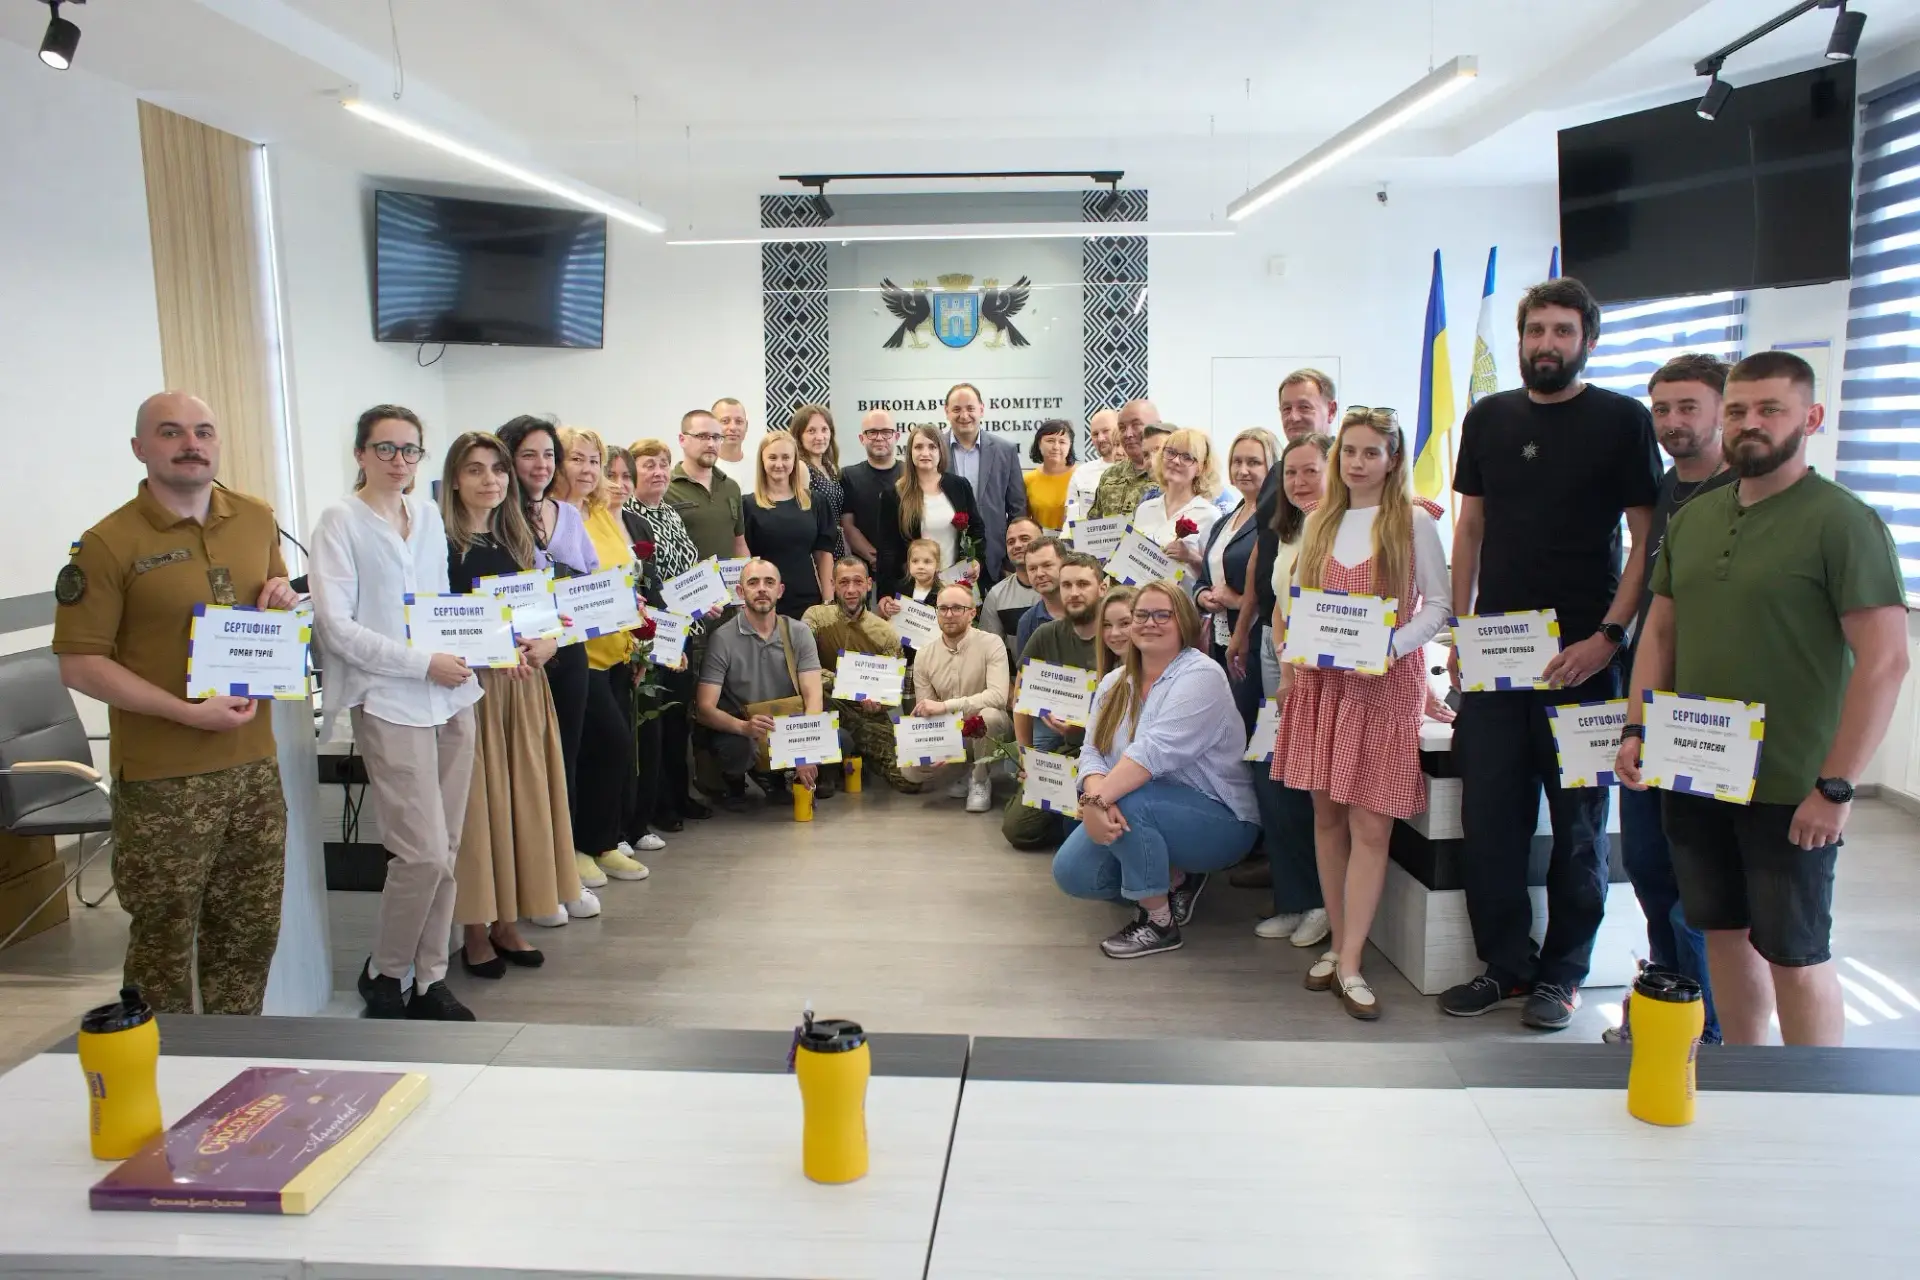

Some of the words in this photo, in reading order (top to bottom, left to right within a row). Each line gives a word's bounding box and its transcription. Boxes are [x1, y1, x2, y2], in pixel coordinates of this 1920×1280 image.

[858, 399, 946, 411] ВИКОНАВЧ
[989, 397, 1063, 409] КОМІТЕТ
[568, 580, 611, 595] СЕРТИФІКАТ
[433, 606, 485, 617] СЕРТИФІКАТ
[1316, 602, 1368, 618] СЕРТИФІКАТ
[224, 621, 282, 635] СЕРТИФІКАТ
[1319, 625, 1338, 634] АЛІНА
[1477, 623, 1529, 636] СЕРТИФІКАТ
[229, 648, 253, 658] РОМАН
[1481, 646, 1508, 655] МАКСИМ
[1578, 713, 1627, 727] СЕРТИФІКА
[1672, 709, 1731, 728] СЕРТИФІКАТ
[1673, 737, 1698, 748] АНДРІЙ
[1699, 741, 1726, 752] СТАСЮК
